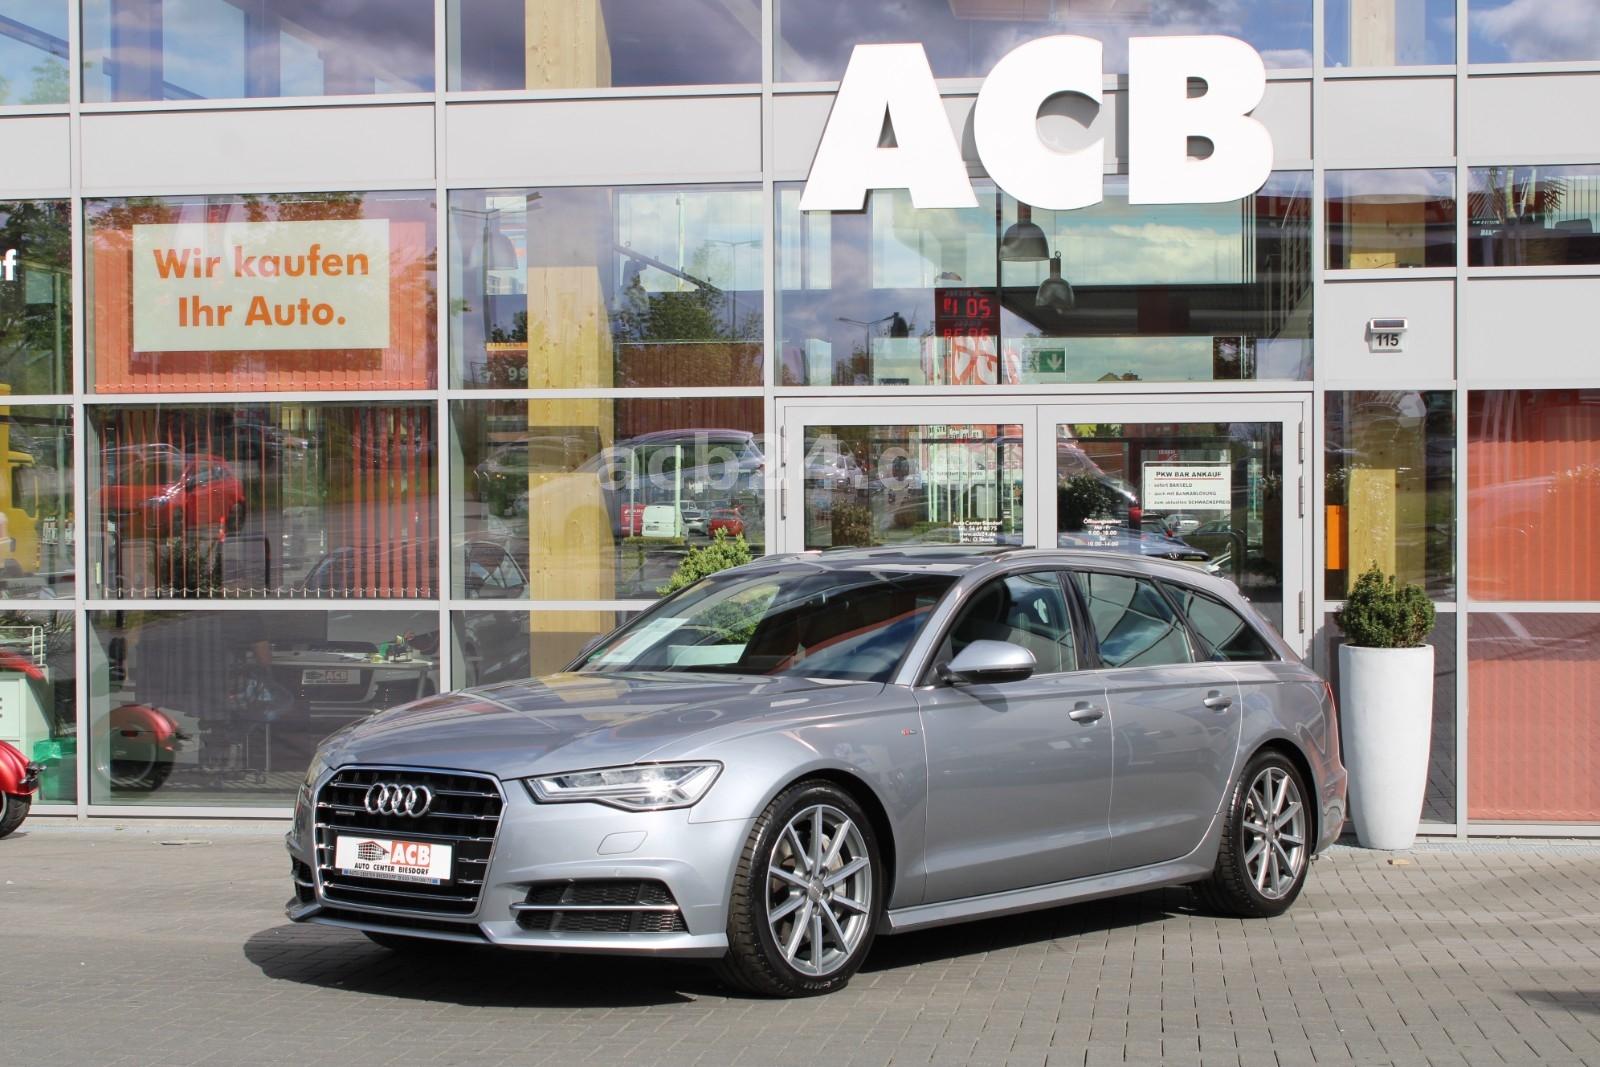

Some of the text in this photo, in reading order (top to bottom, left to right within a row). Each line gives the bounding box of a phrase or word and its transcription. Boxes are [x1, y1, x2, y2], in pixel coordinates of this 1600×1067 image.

[800, 34, 1274, 210] ACB
[0, 249, 17, 281] f
[153, 243, 370, 279] Wir kaufen
[178, 294, 347, 328] Ihr Auto.
[1375, 333, 1400, 347] 115
[354, 862, 430, 876] AUTO CENTER BIESDORF
[391, 842, 431, 866] ACB
